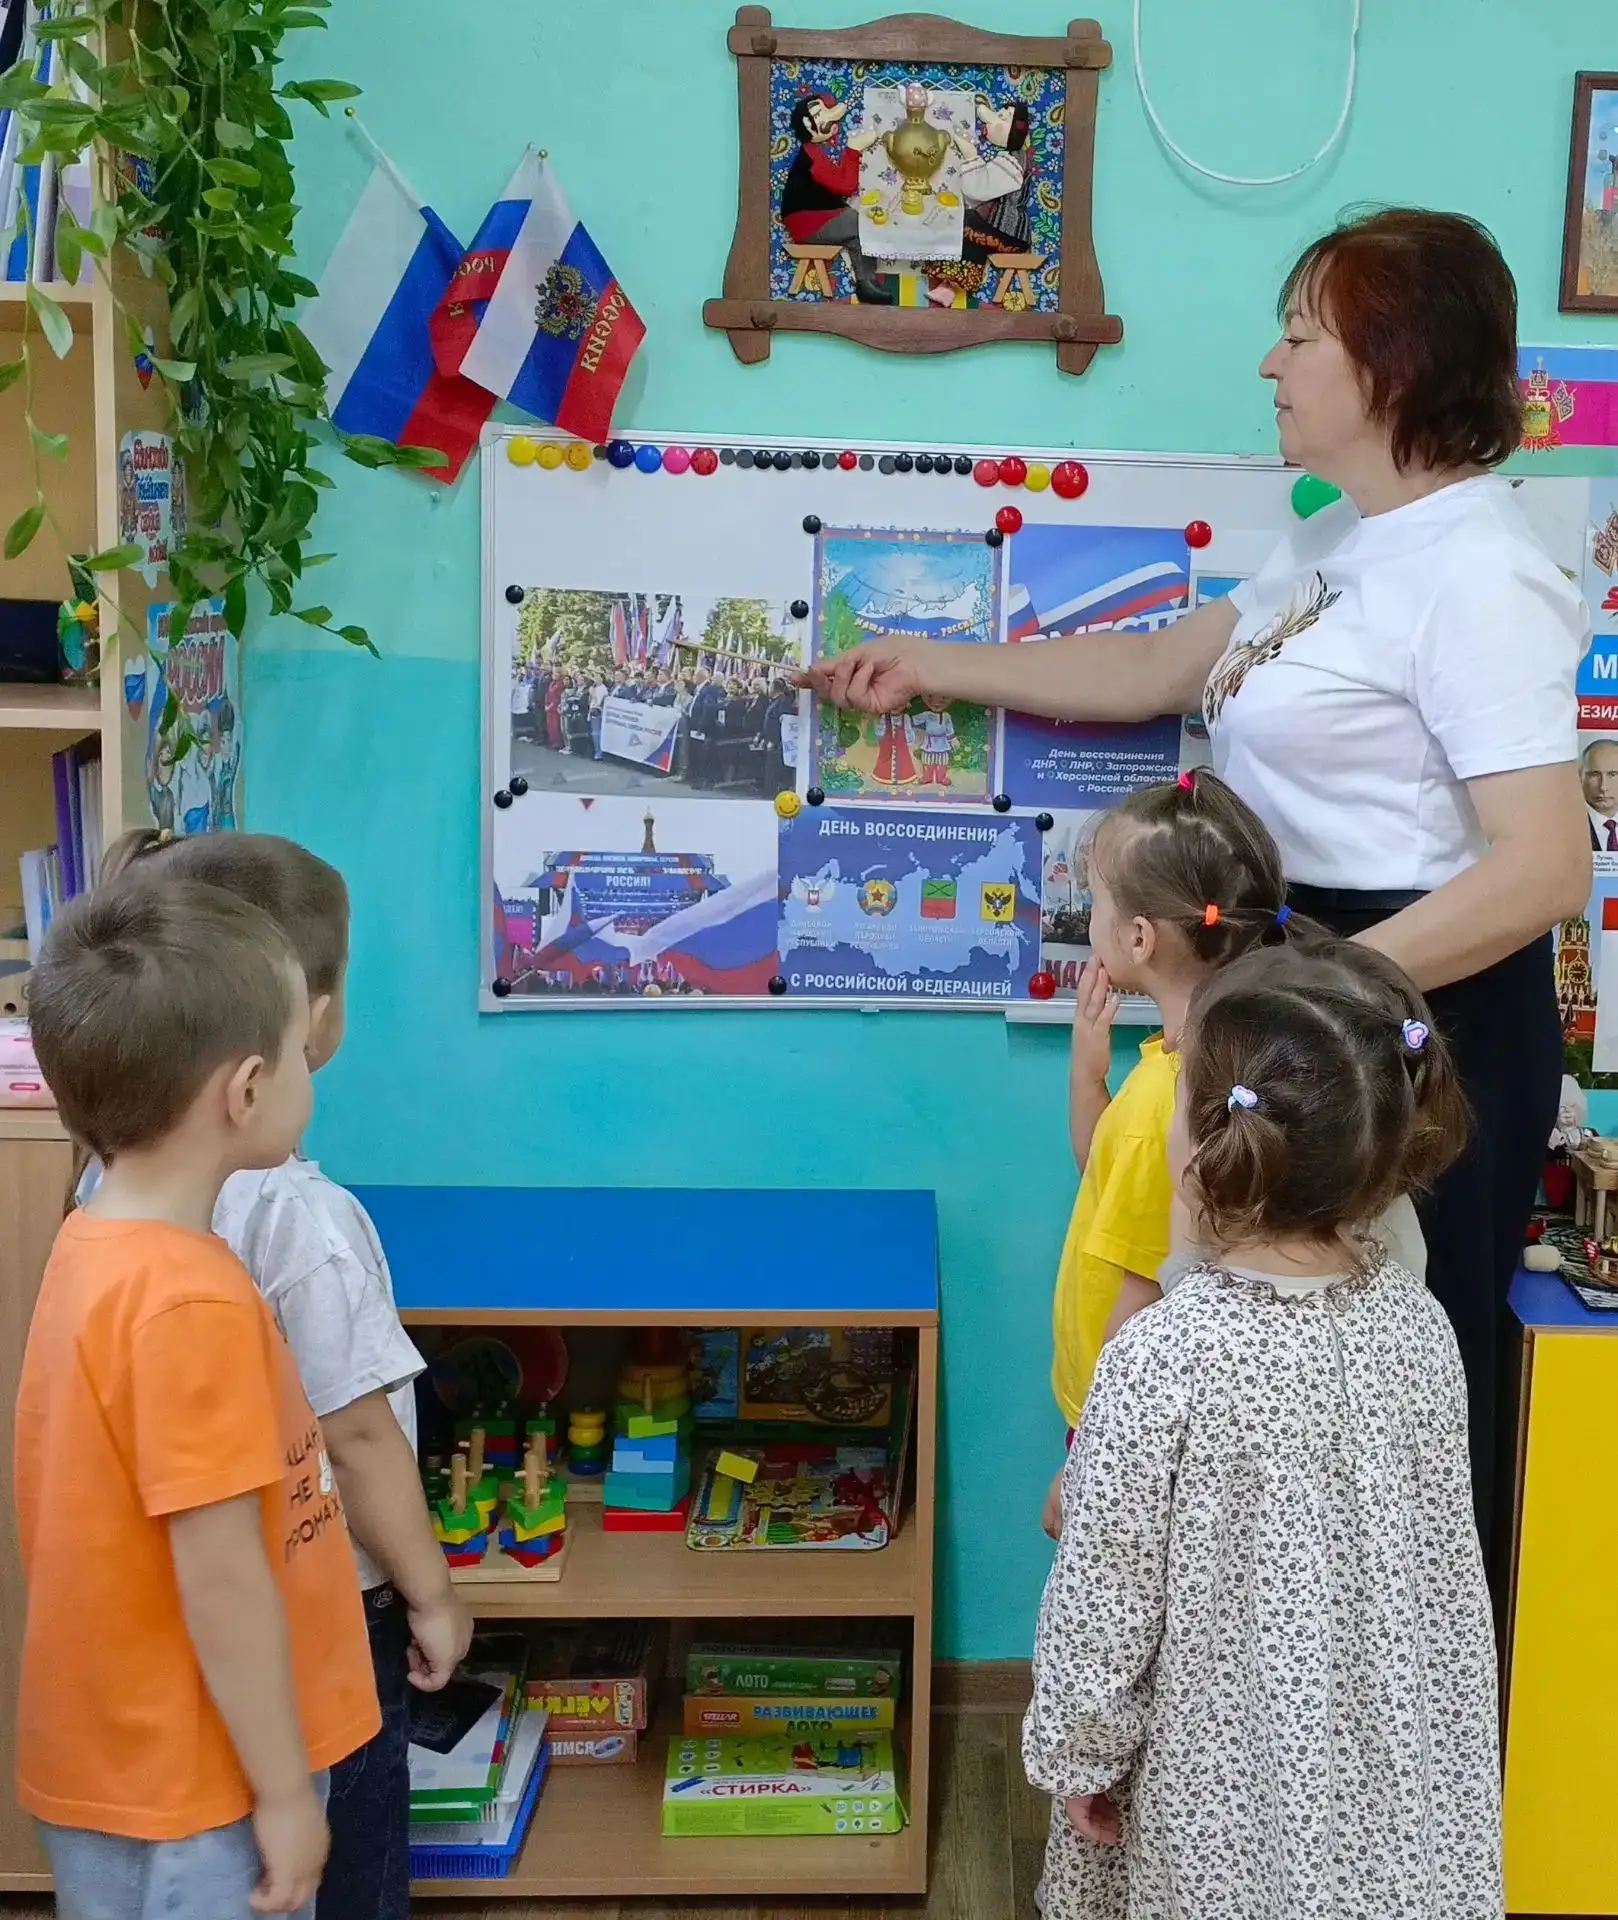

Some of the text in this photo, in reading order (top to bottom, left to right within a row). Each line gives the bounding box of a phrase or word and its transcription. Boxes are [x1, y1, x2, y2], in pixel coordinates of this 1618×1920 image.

[1577, 704, 1618, 721] ЕЗИД
[1049, 748, 1165, 761] День воссоединения
[1031, 759, 1058, 770] ДНР,
[1069, 761, 1095, 771] ЛНР,
[1056, 771, 1121, 782] Херсонской
[1078, 783, 1134, 794] с Россией
[819, 820, 998, 842] ДЕНЬ ВОССОЕДИНЕНИЯ
[790, 972, 1012, 996] С РОССИЙСКОЙ ФЕДЕРАЦИЕЙ
[289, 1474, 314, 1510] НЕ
[735, 1674, 769, 1689] ЛОТО
[703, 1712, 739, 1722] STELLAR
[752, 1705, 880, 1720] РАЗВИВАЮЩЕЕ
[786, 1720, 833, 1732] ЛОТО
